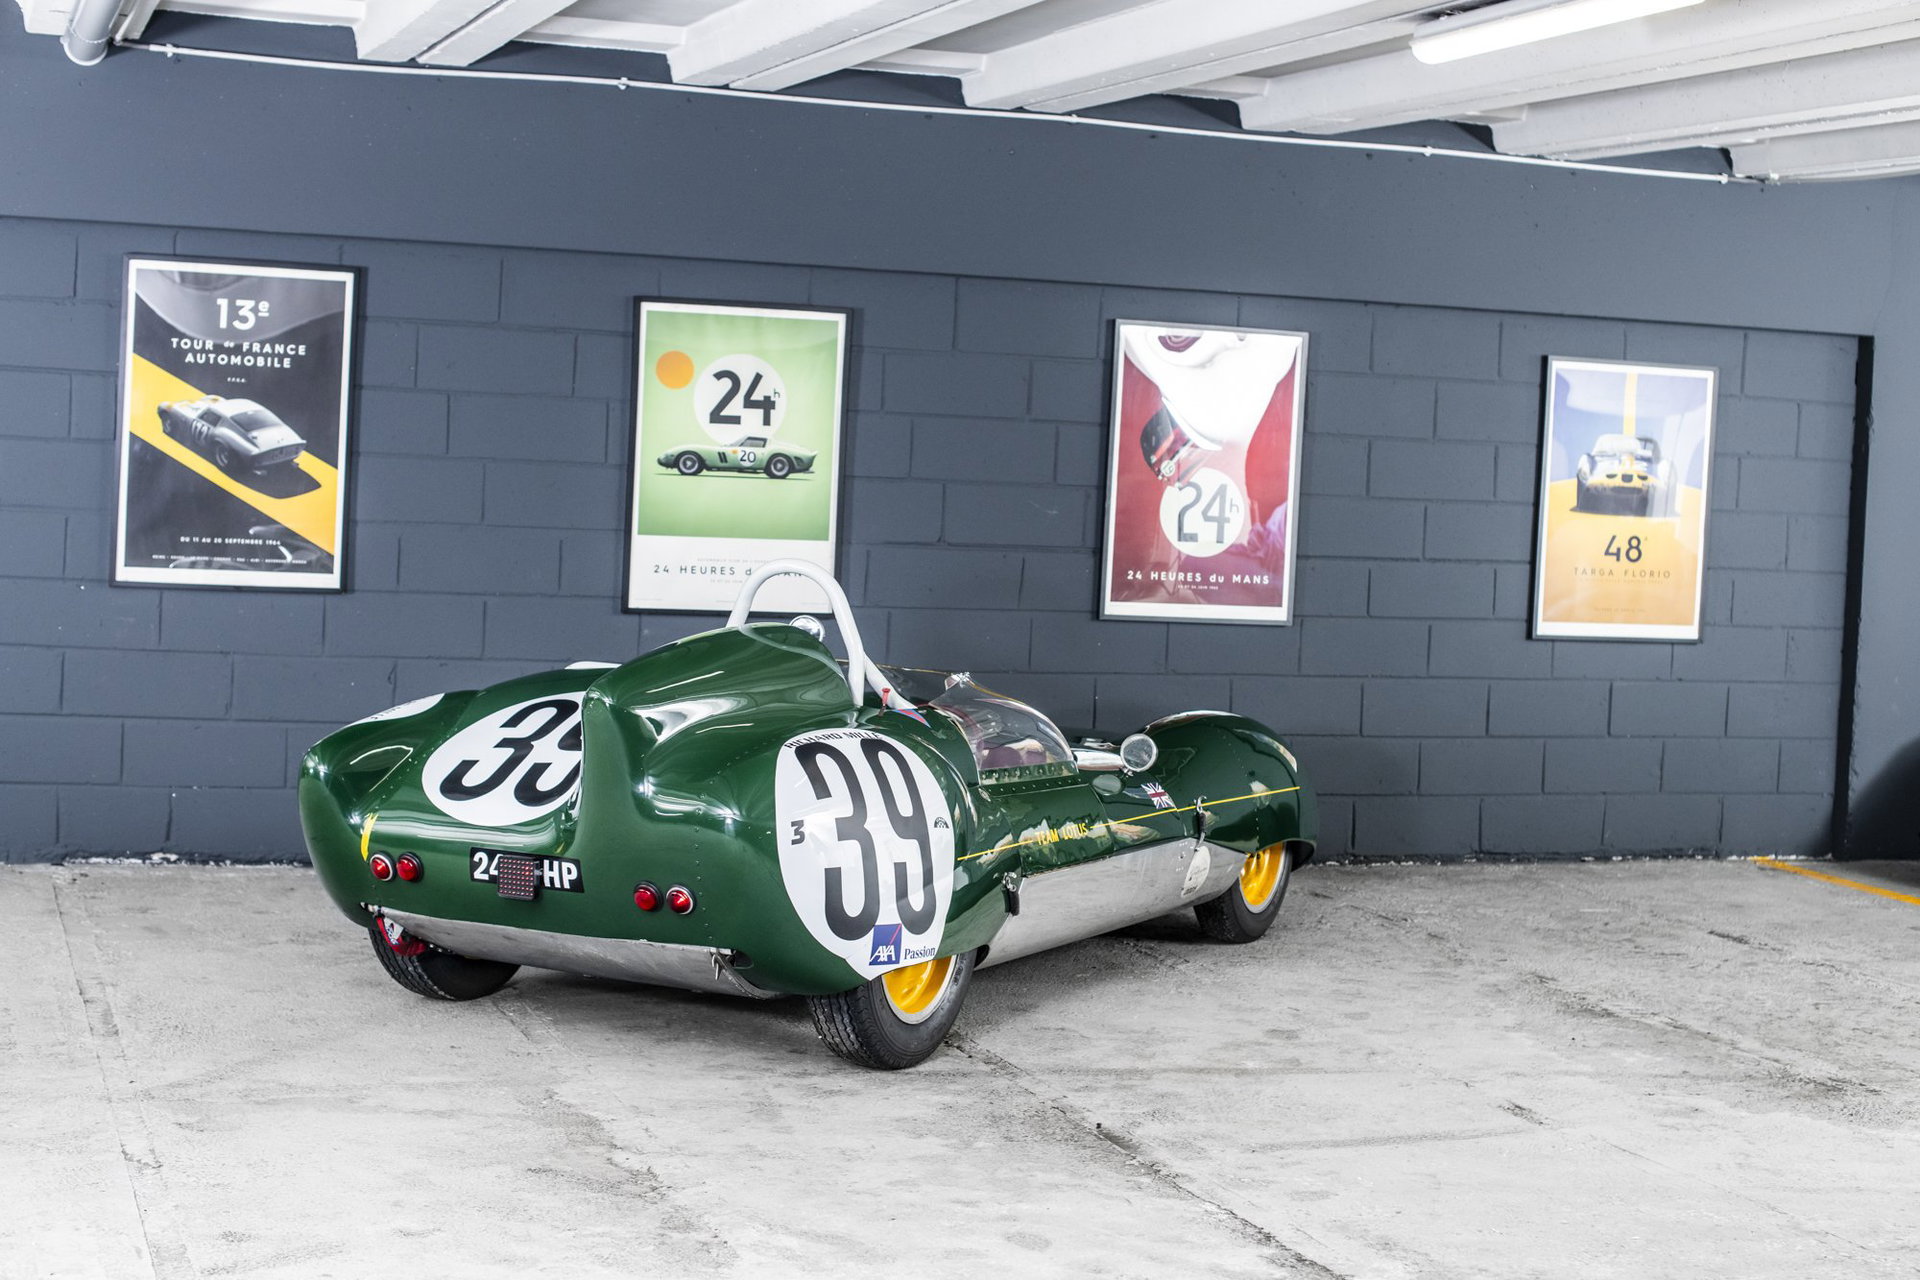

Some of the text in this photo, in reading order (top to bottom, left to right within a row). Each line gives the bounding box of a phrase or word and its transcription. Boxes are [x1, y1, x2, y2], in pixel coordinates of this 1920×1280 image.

[171, 337, 307, 356] TOUR de FRANCE
[184, 352, 292, 368] AUTOMOBILE
[740, 450, 756, 463] 20
[224, 537, 263, 546] SEPTEMBRE
[653, 564, 670, 574] 24
[679, 565, 736, 576] HEURES
[1127, 570, 1270, 585] 24 HEURES du MANS
[1573, 567, 1671, 579] TARGA FLORIO
[784, 731, 880, 749] RICHARD MILLE
[790, 820, 806, 846] 3
[794, 738, 937, 941] 39
[1036, 822, 1088, 846] TEAM LOTUS
[543, 859, 578, 889] HP
[870, 945, 936, 962] AXA Passion
